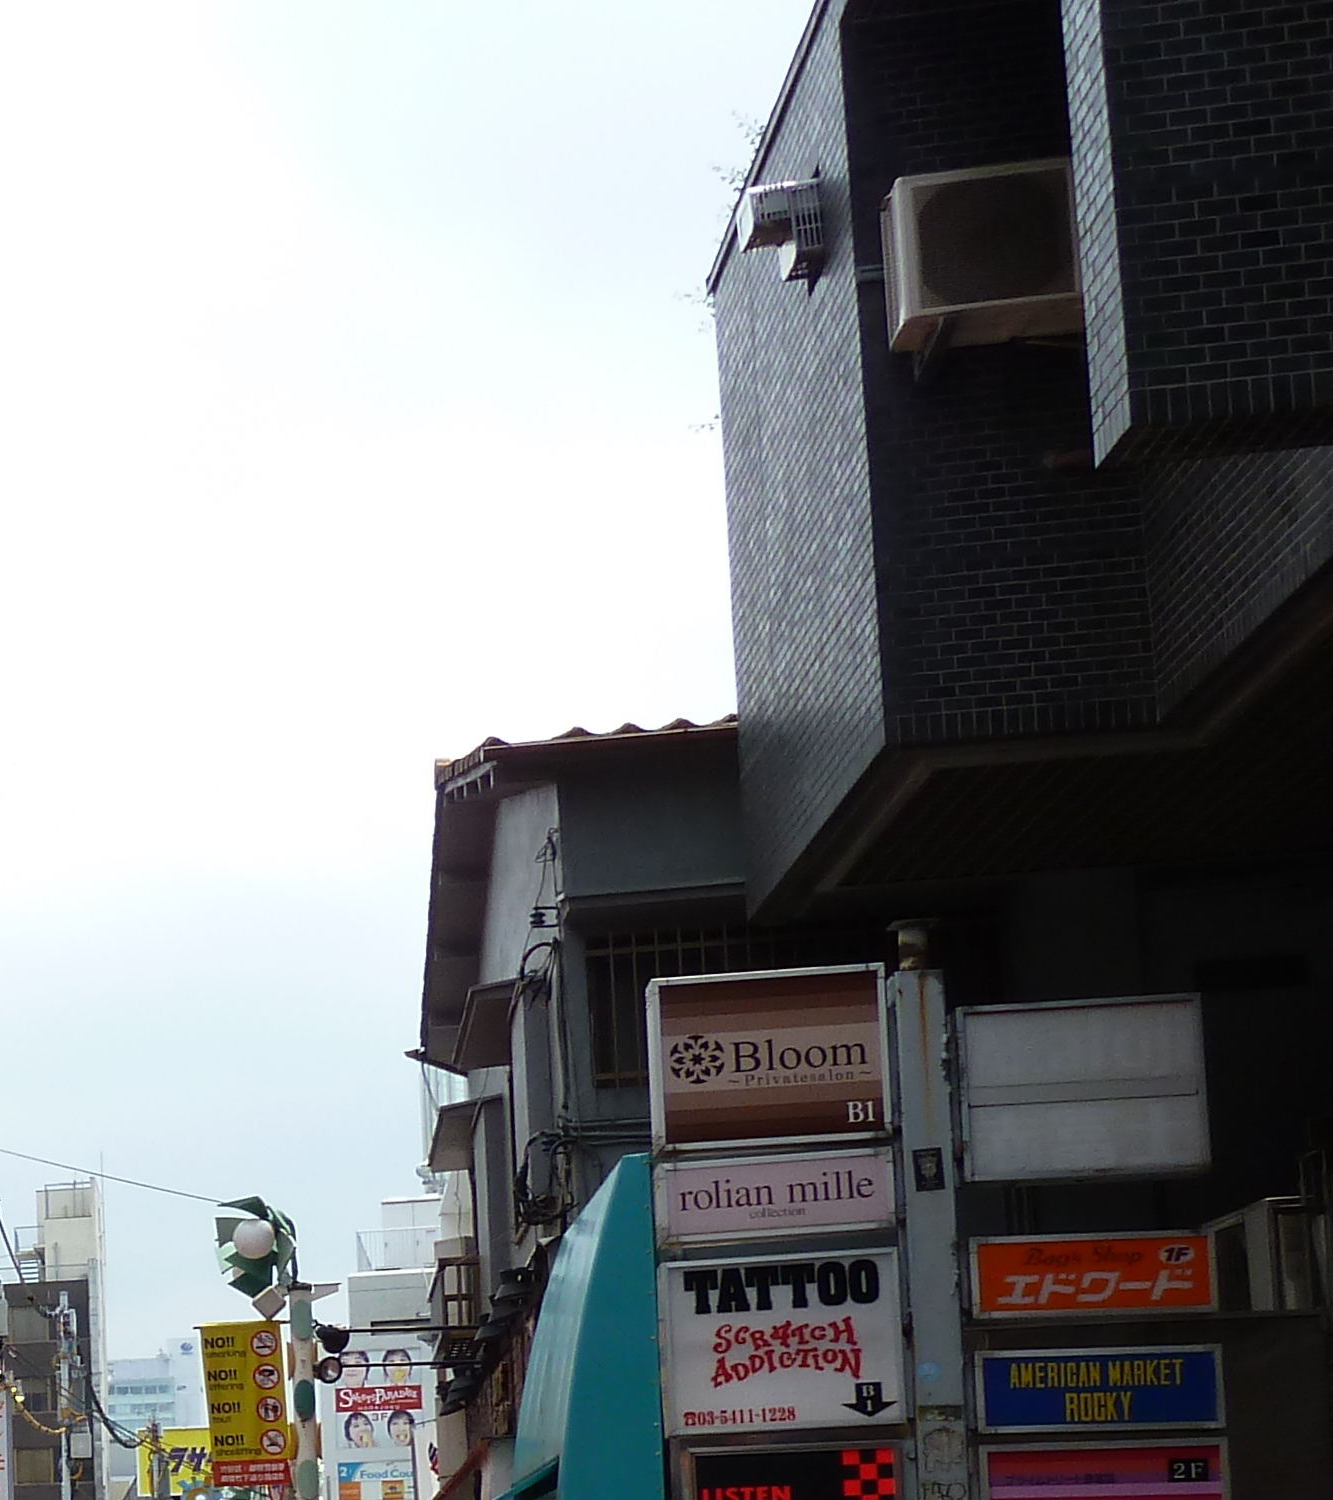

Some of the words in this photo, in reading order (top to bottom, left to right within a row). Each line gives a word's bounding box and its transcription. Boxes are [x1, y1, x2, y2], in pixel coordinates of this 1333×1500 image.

[729, 1038, 868, 1073] Bloom
[846, 1101, 876, 1123] B1
[679, 1178, 773, 1212] rolian
[787, 1170, 874, 1201] mille
[748, 1204, 806, 1219] collection
[1162, 1245, 1191, 1263] 1F
[683, 1259, 881, 1315] TATTOO
[997, 1269, 1194, 1306] エドワード
[204, 1336, 235, 1350] NO!!
[207, 1369, 237, 1383] NO!!
[710, 1347, 863, 1389] ADDICTION
[1009, 1360, 1101, 1389] AMERICAN
[1107, 1358, 1184, 1387] MARKET
[211, 1401, 241, 1416] NO!!
[1064, 1391, 1133, 1422] ROCKY
[371, 1412, 388, 1422] 3F
[695, 1406, 797, 1427] 03-5411-1228
[214, 1434, 245, 1447] NO!!
[360, 1469, 389, 1480] Food
[390, 1468, 413, 1479] Cou
[1172, 1462, 1204, 1480] 2F
